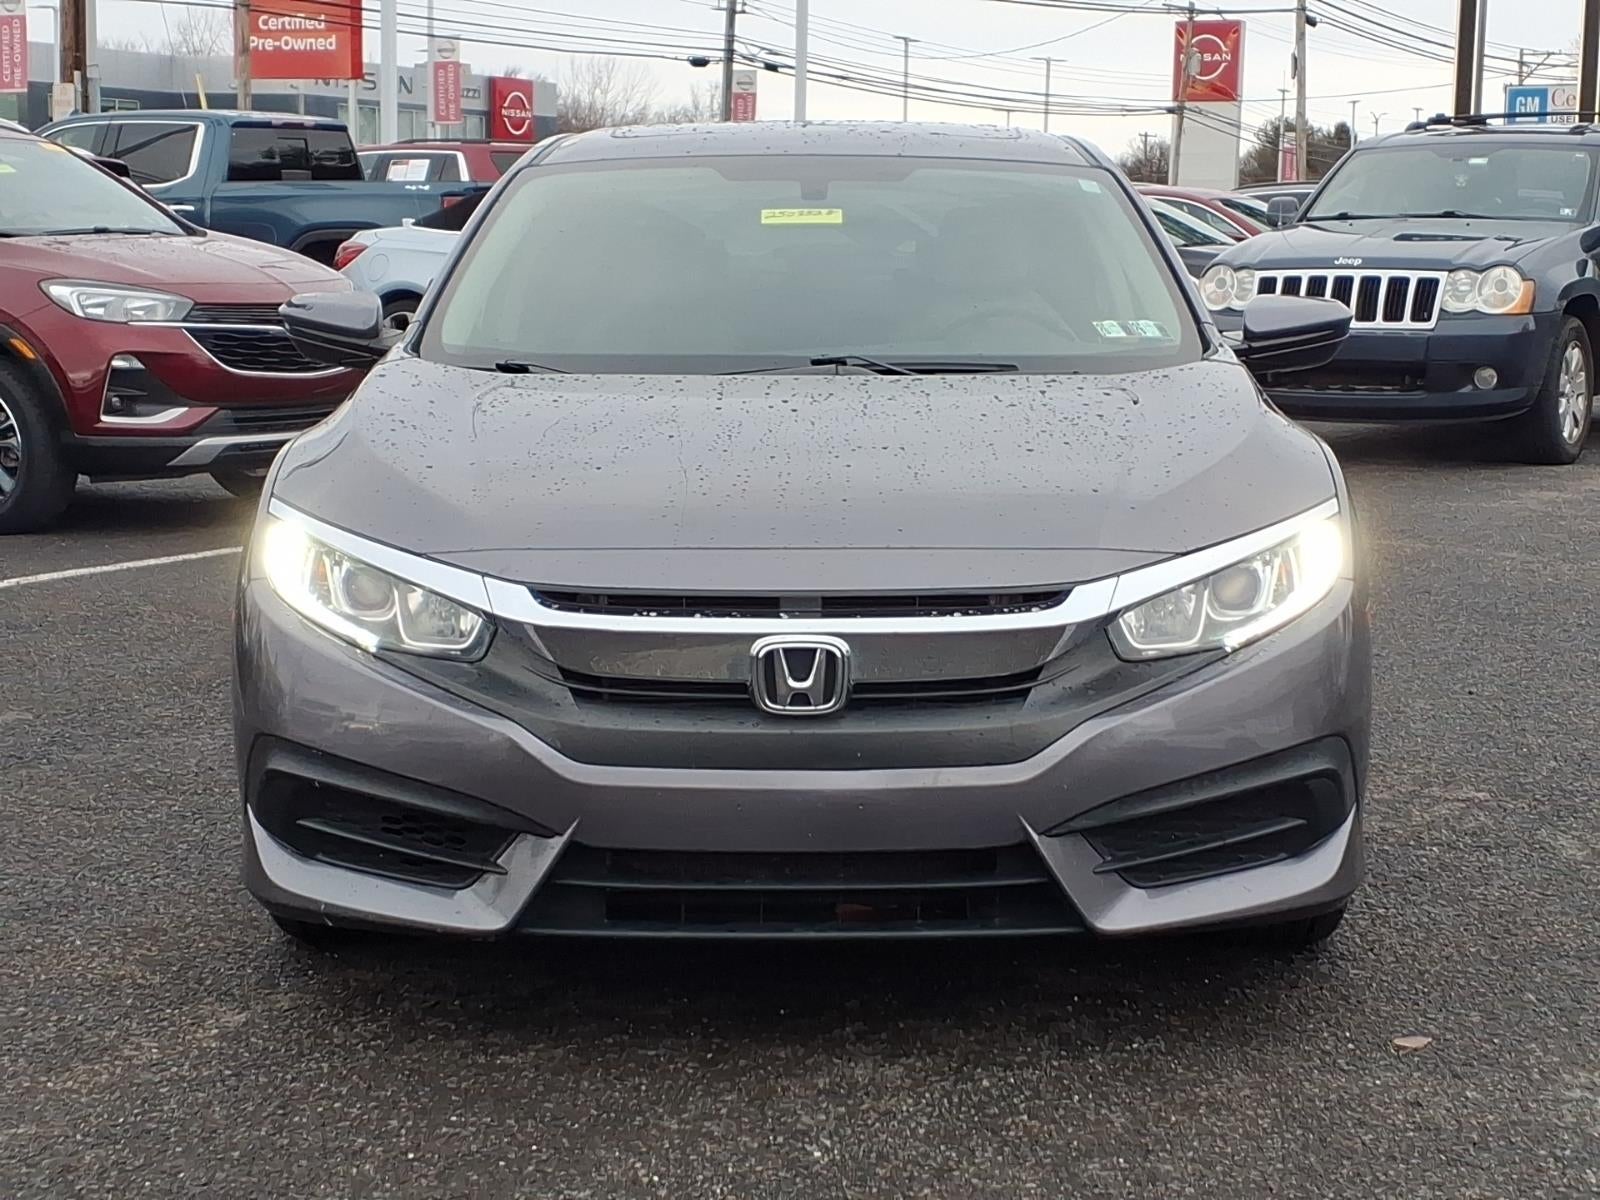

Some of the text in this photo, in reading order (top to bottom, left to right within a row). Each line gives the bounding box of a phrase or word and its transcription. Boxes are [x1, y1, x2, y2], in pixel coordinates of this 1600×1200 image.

[258, 14, 325, 30] Certified
[250, 35, 336, 50] Pre-Owned
[1515, 96, 1540, 113] GM
[501, 107, 531, 118] NISSAN
[1334, 257, 1362, 266] Jeep
